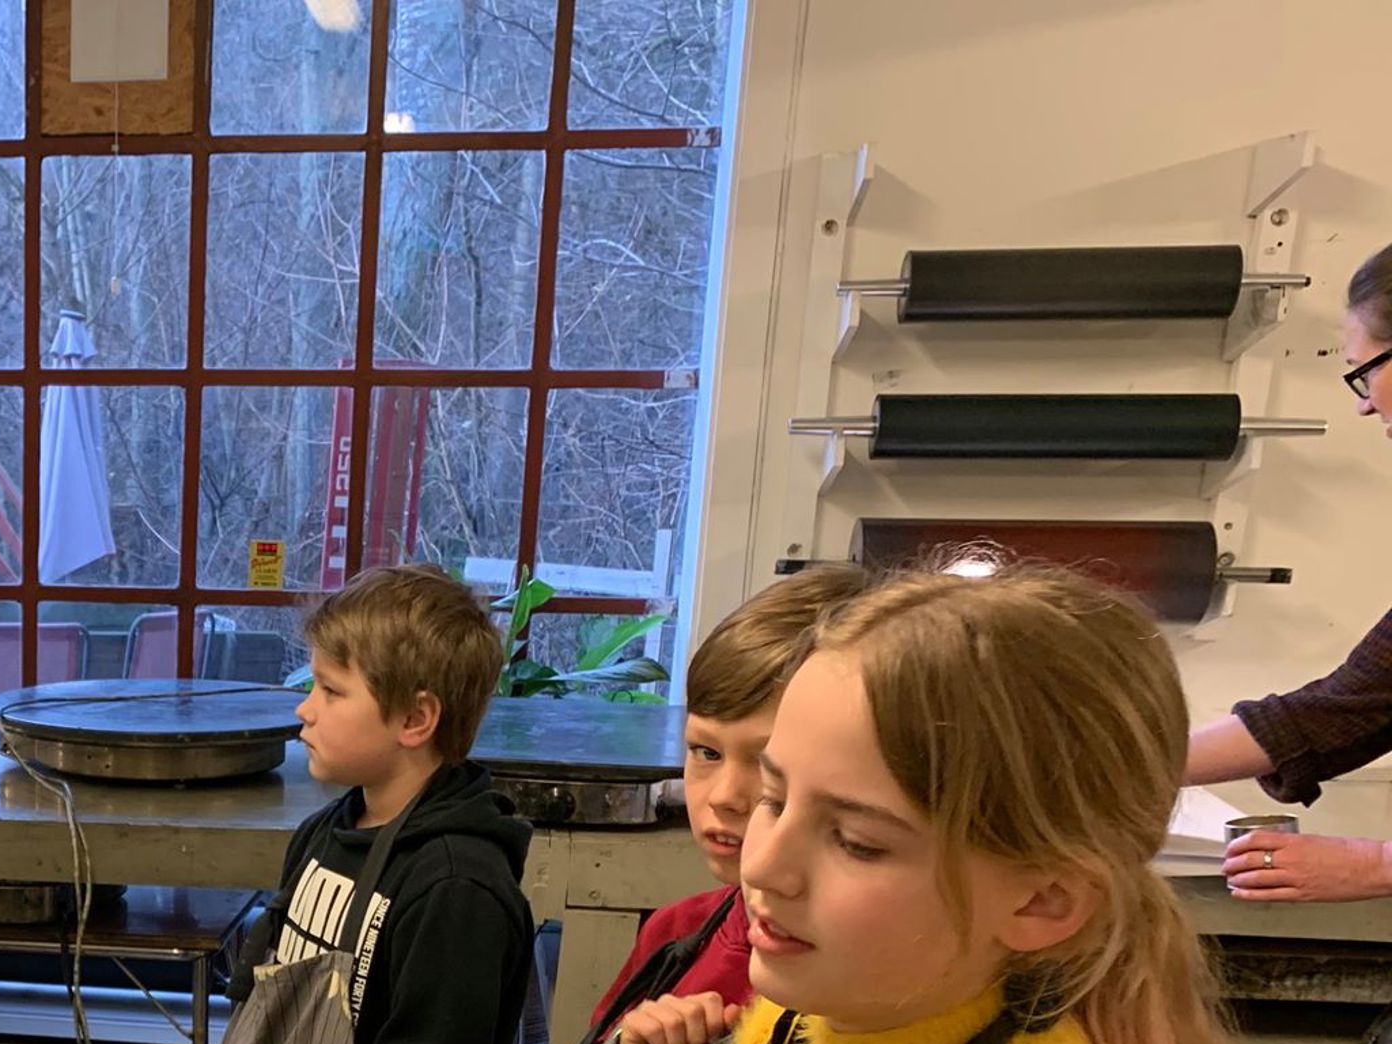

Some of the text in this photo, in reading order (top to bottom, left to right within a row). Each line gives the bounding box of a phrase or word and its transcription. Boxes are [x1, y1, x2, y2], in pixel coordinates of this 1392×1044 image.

[351, 898, 391, 1012] SINCE NINETEEN FORTY
